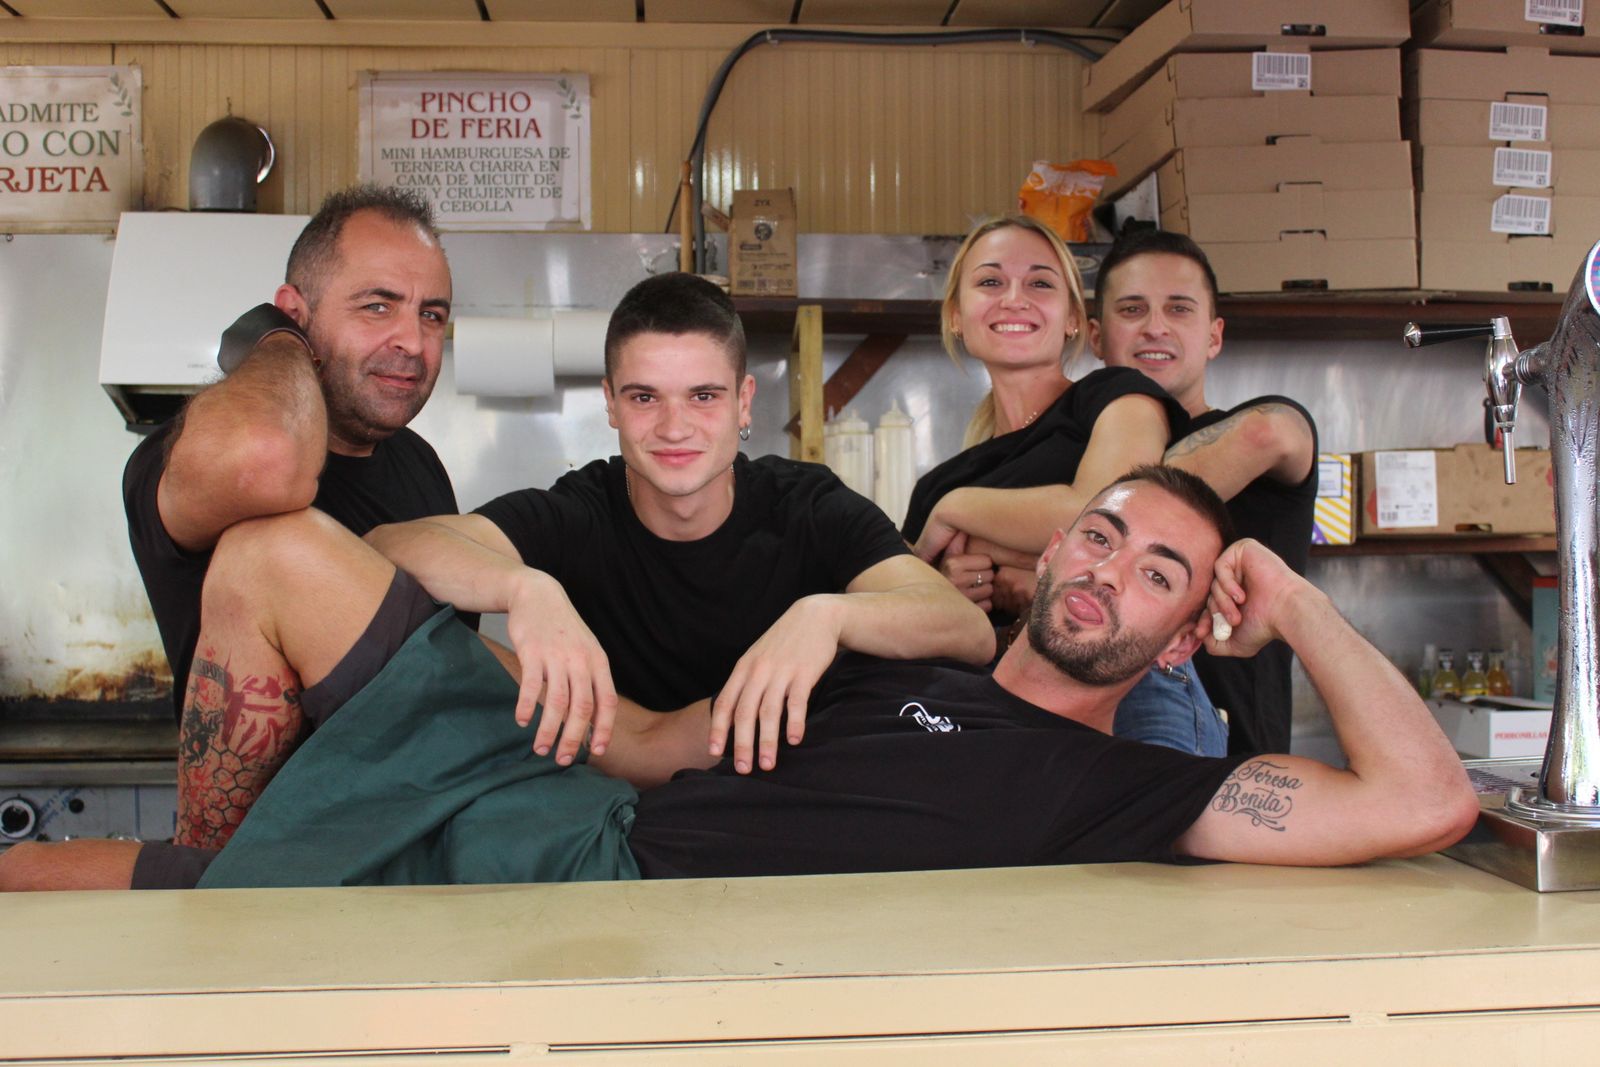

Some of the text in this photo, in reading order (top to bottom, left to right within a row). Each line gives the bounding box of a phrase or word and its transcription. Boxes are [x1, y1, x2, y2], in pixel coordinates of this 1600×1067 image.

[421, 91, 532, 113] PINCHO
[411, 118, 543, 139] DE FERIA
[42, 129, 121, 157] CON
[381, 147, 571, 160] MINI HAMBURGUESA DE
[391, 160, 561, 173] TERNERA CHARRA EN
[0, 166, 111, 193] RJETA
[396, 173, 556, 187] CAMA DE MICUIT DE
[433, 187, 442, 199] Y
[446, 186, 535, 200] CRUJIENTE
[540, 186, 563, 199] DE
[439, 201, 513, 213] CEBOLLA
[1237, 761, 1303, 789] Teresa
[1212, 782, 1284, 812] Benita
